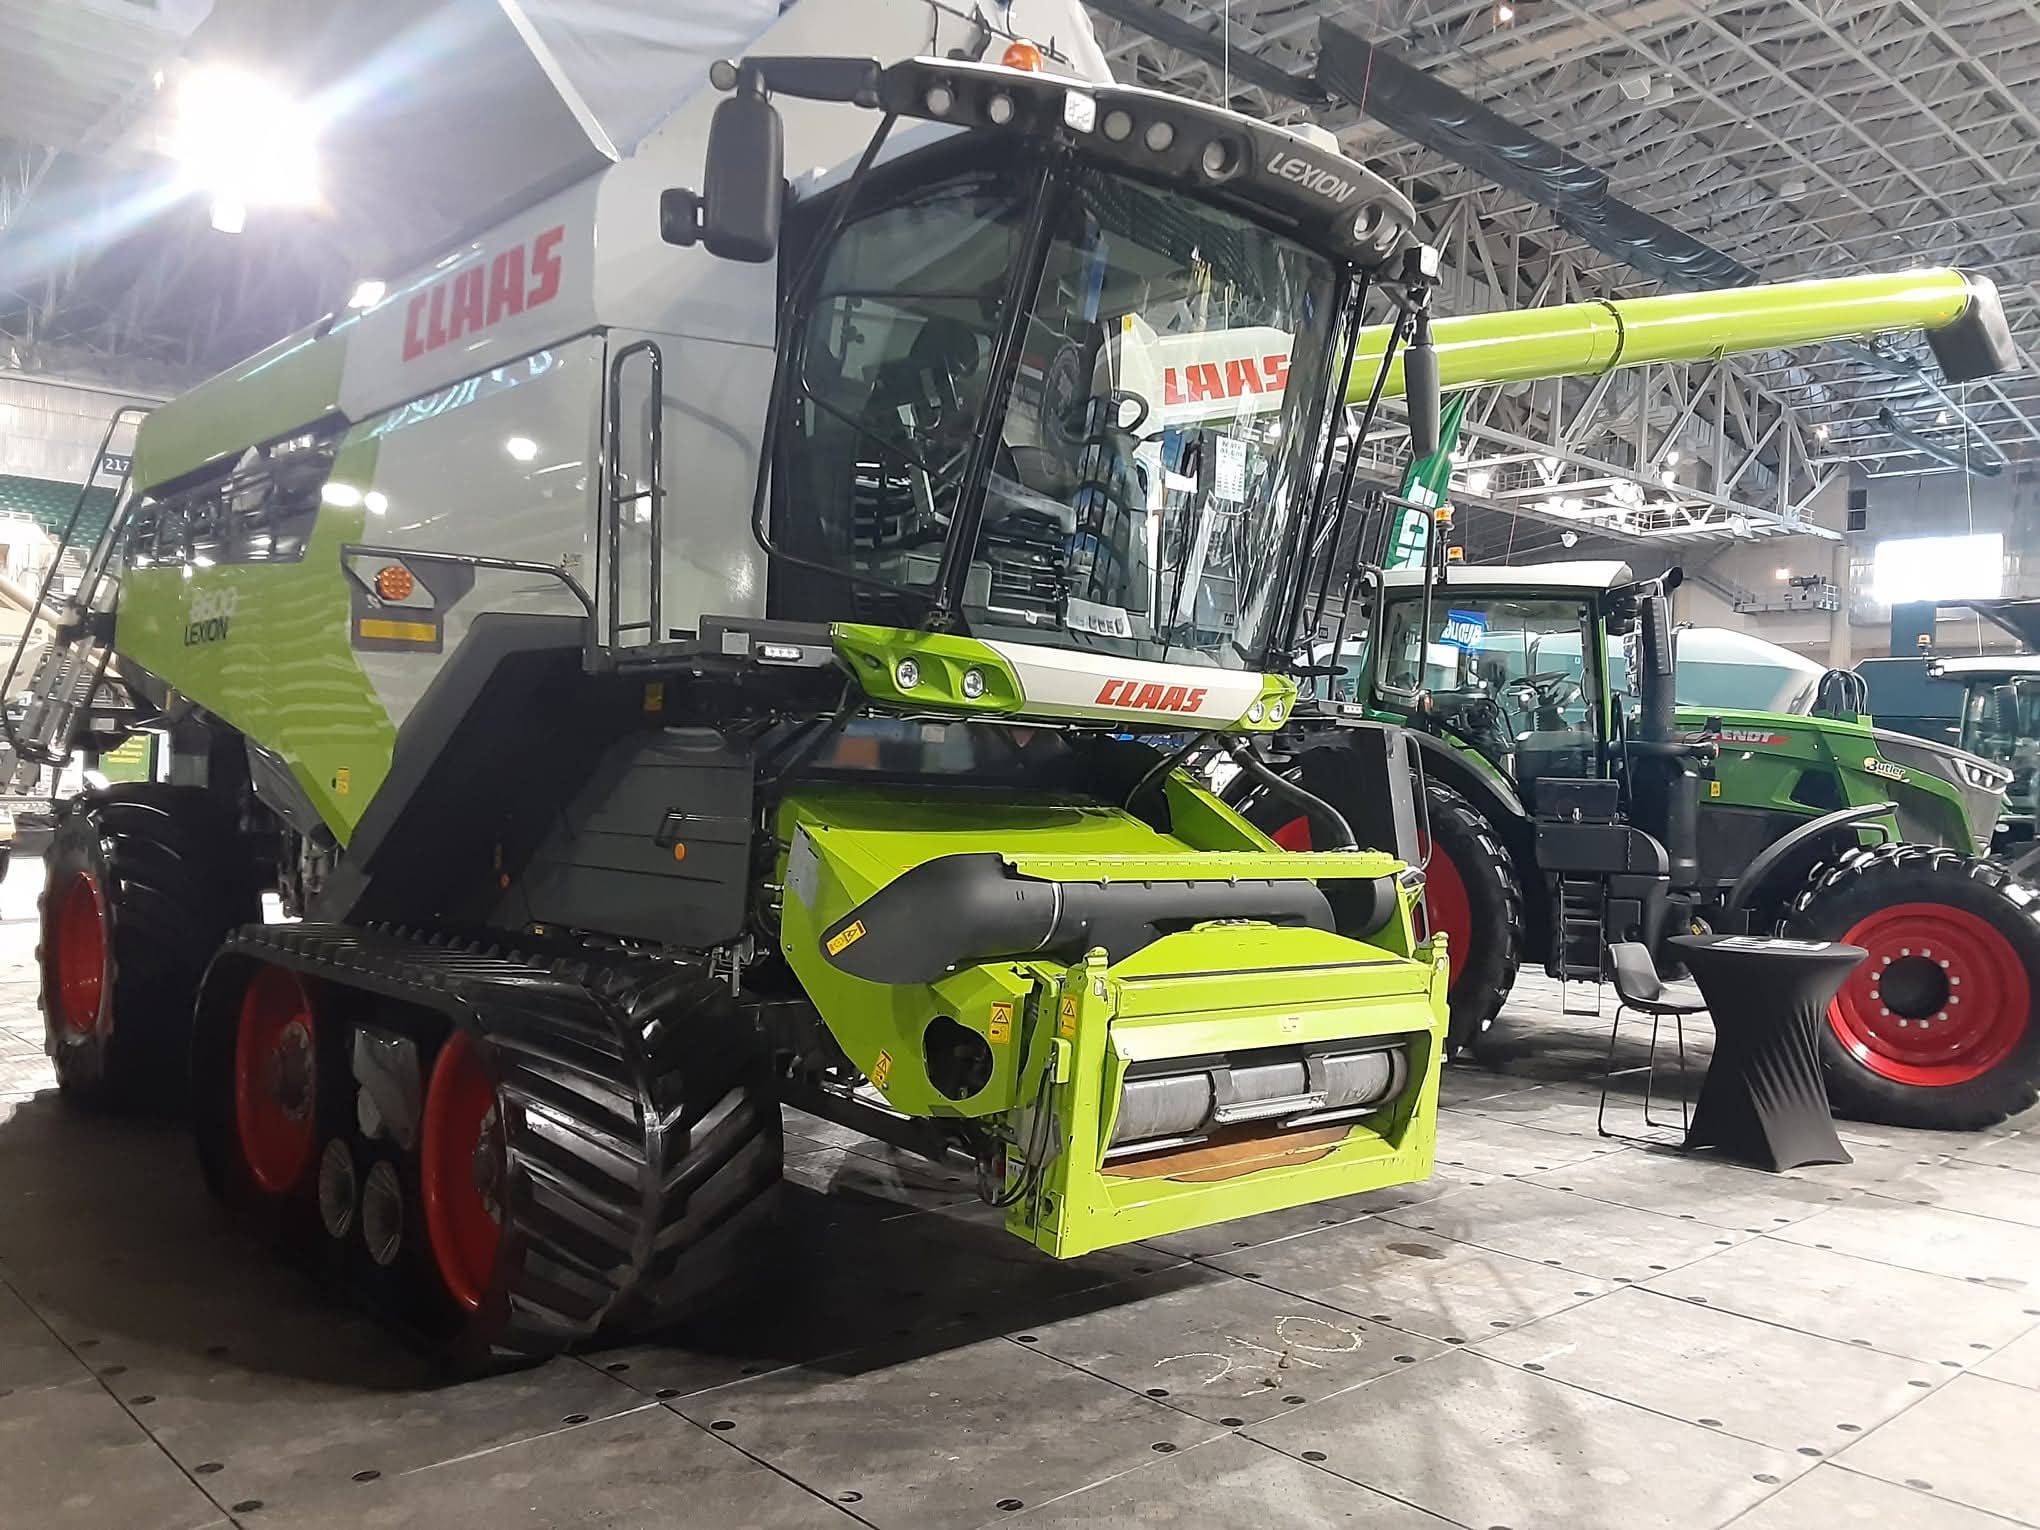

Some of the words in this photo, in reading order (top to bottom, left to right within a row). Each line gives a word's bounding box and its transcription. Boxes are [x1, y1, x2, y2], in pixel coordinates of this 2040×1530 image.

[1266, 152, 1357, 203] LEXION
[402, 223, 566, 363] CLAAS
[105, 458, 130, 472] 217
[184, 616, 229, 647] LEXION
[1094, 679, 1209, 713] CLAAS
[1865, 758, 1905, 776] Butler
